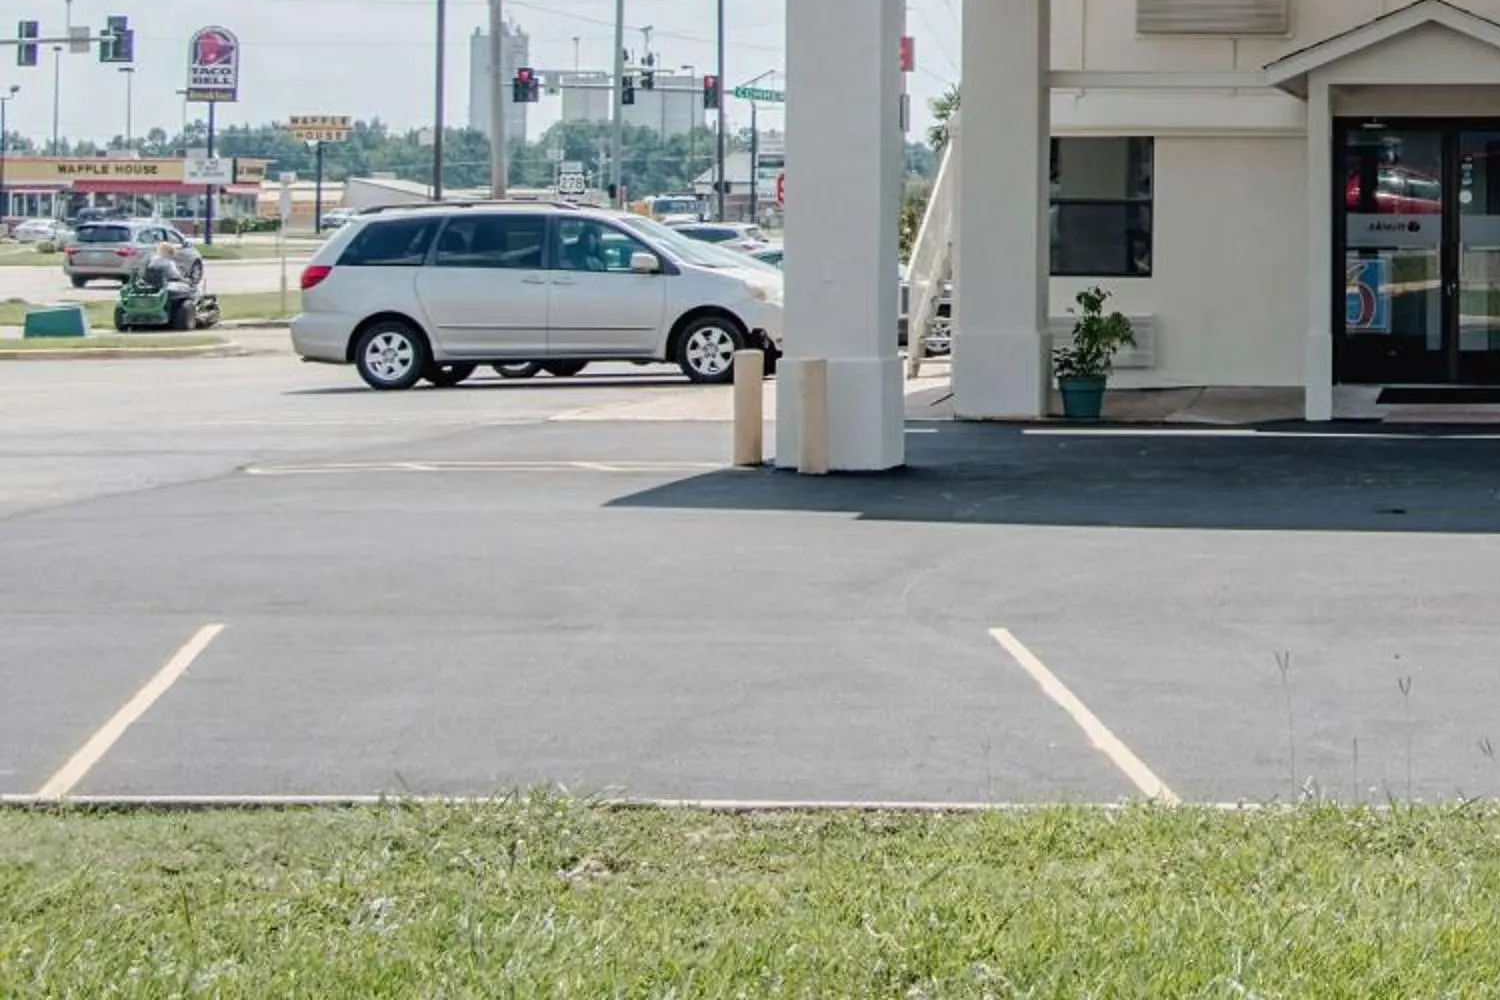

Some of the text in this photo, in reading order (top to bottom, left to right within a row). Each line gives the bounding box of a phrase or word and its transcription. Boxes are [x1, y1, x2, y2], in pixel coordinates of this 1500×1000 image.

[192, 67, 232, 75] TACO
[192, 77, 233, 85] BELL
[115, 163, 159, 175] HOUSE
